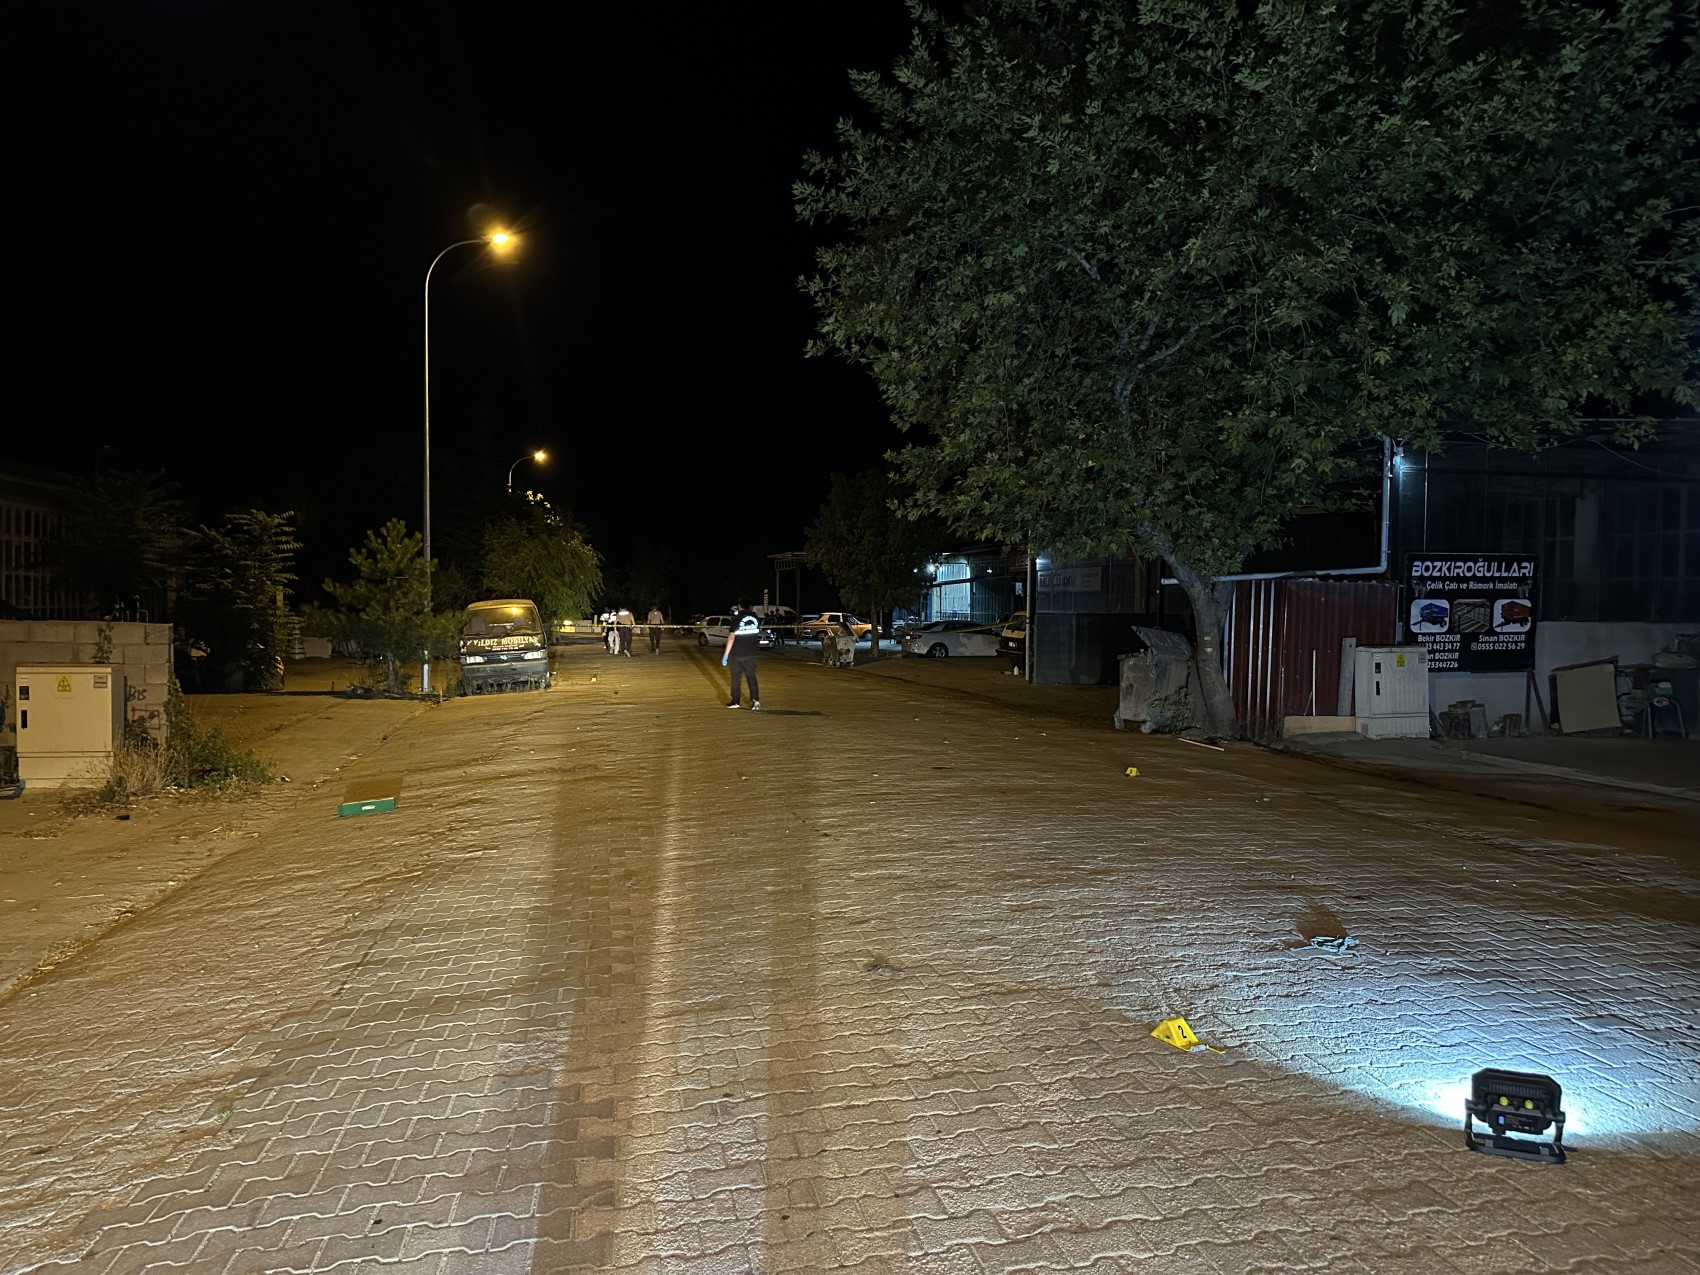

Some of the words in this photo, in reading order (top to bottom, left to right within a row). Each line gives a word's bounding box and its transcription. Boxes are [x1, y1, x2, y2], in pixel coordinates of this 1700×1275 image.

[1412, 558, 1534, 577] BOZKIROĞULLARI
[1426, 581, 1443, 591] Çelik
[1444, 581, 1458, 591] Çatı
[1468, 580, 1494, 590] Römork
[1417, 634, 1435, 642] Bekir
[1435, 634, 1461, 642] BOZKIR
[1478, 634, 1498, 642] Sinan
[1498, 634, 1526, 642] BOZKIR
[1432, 642, 1444, 650] 443
[1444, 642, 1452, 650] 34
[1452, 642, 1460, 650] 77
[1477, 642, 1494, 650] 0555
[1494, 642, 1507, 650] 022
[1507, 642, 1516, 650] 56
[1516, 642, 1526, 650] 29
[1434, 652, 1460, 660] BOZKIR
[1427, 661, 1459, 669] 25344726
[1177, 1025, 1187, 1039] 2
